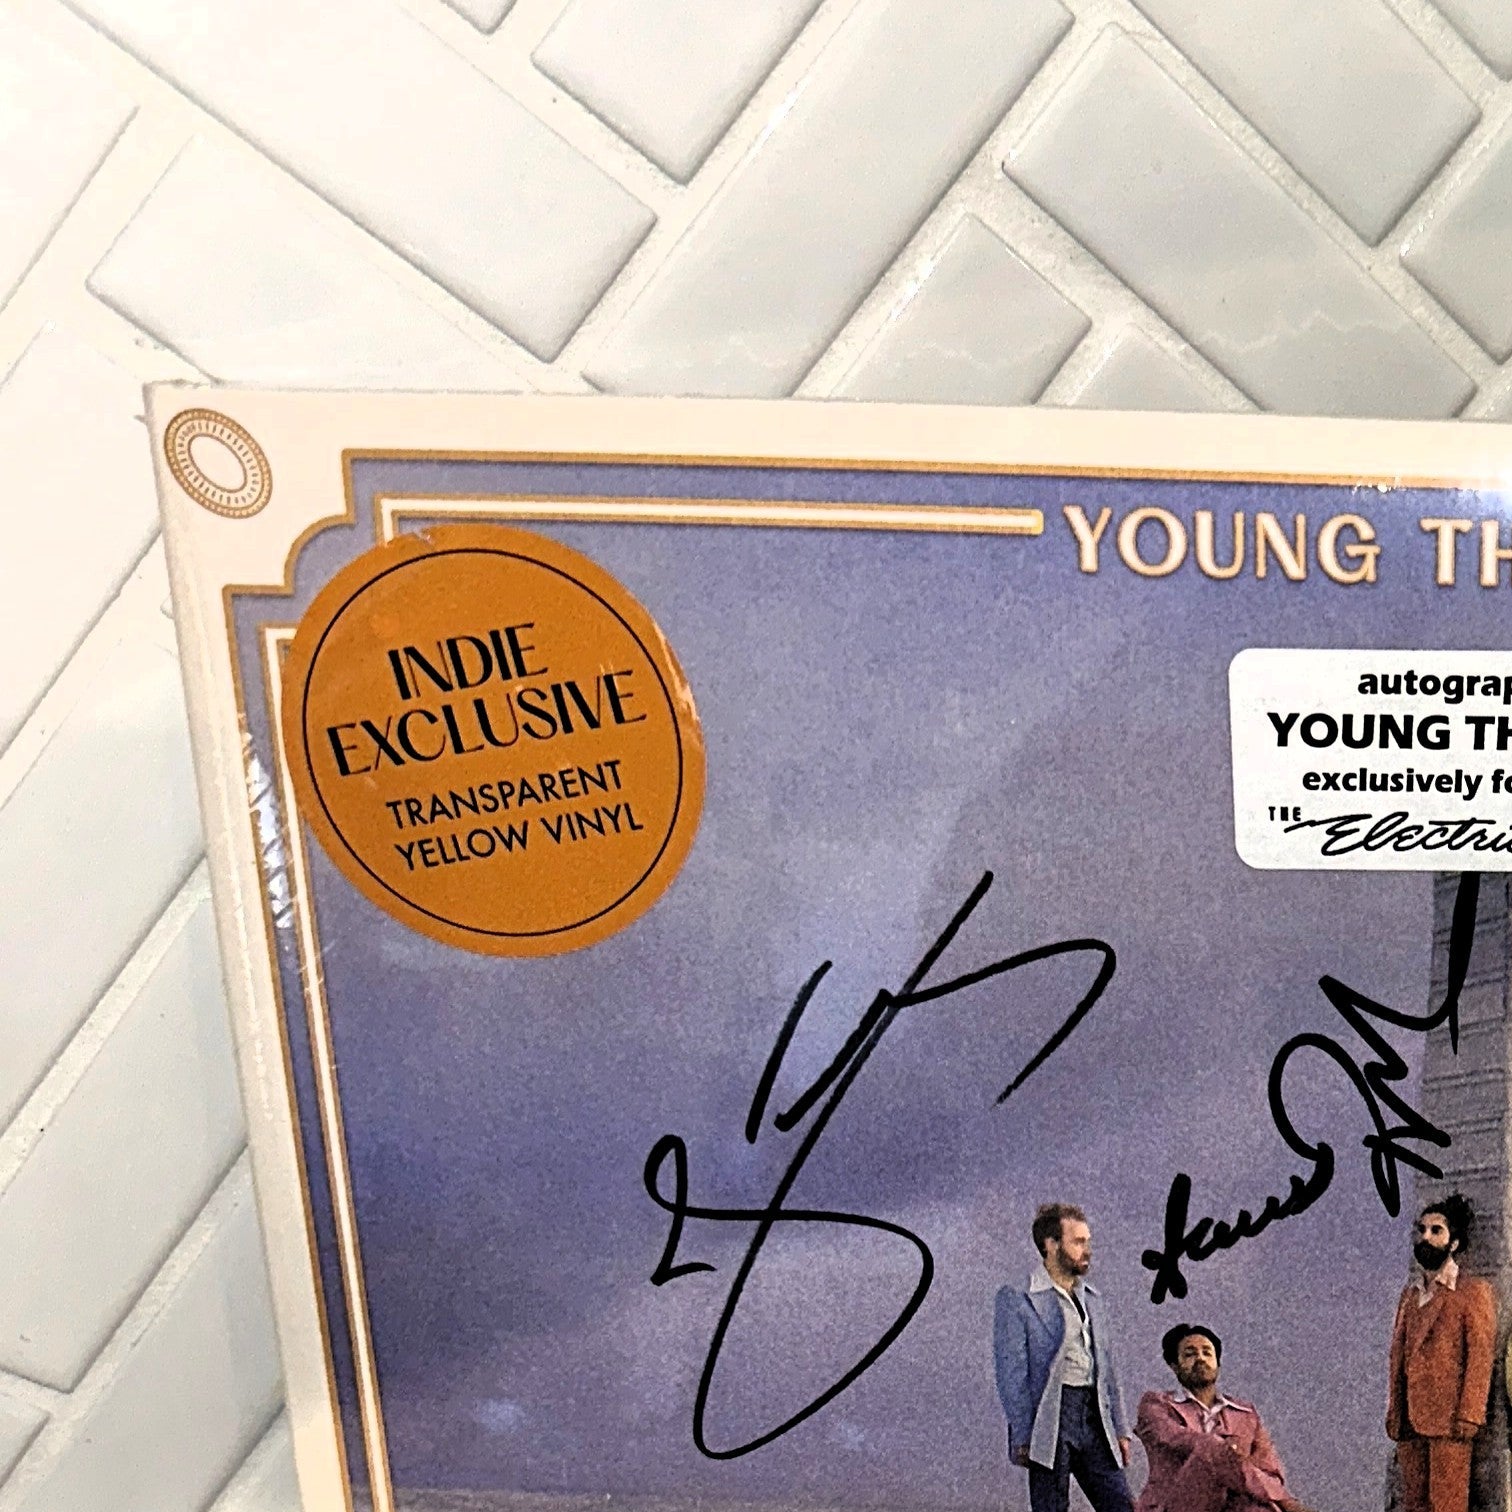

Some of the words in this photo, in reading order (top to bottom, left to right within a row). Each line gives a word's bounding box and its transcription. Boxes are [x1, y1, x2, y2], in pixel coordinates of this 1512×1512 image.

[1061, 502, 1381, 587] YOUNG
[387, 622, 548, 700] INDIE
[326, 669, 647, 777] EXCLUSIVE
[1267, 712, 1451, 751] YOUNG
[386, 759, 622, 829] TRANSPARENT
[1268, 805, 1303, 823] THE
[1302, 769, 1483, 800] exclusively
[394, 819, 530, 871] YELLOW
[541, 802, 644, 845] VINYL
